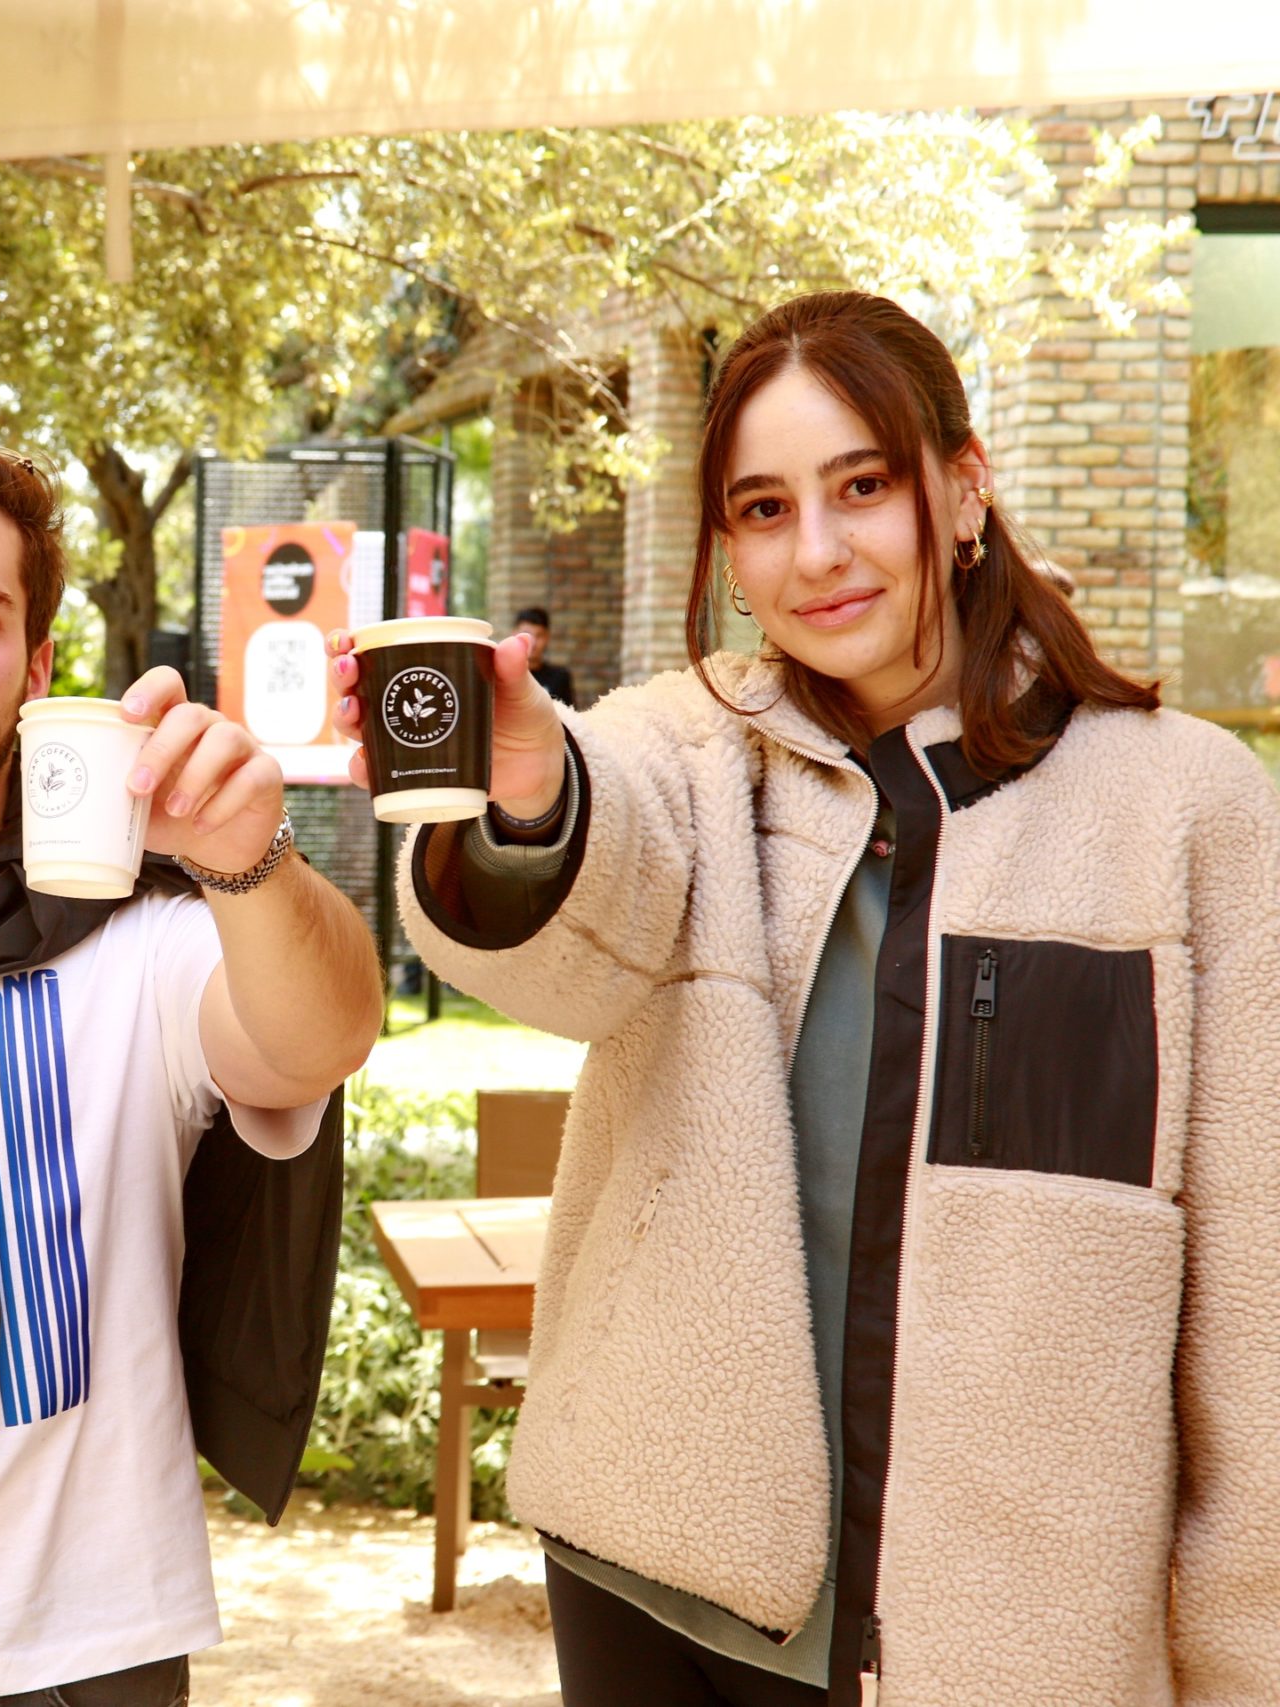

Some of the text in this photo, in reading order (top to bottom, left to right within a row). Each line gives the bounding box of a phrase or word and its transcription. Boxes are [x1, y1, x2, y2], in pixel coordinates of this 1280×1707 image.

[387, 672, 454, 712] KLAR COFFEE CO
[40, 748, 75, 763] COFFEE
[74, 767, 83, 782] CO
